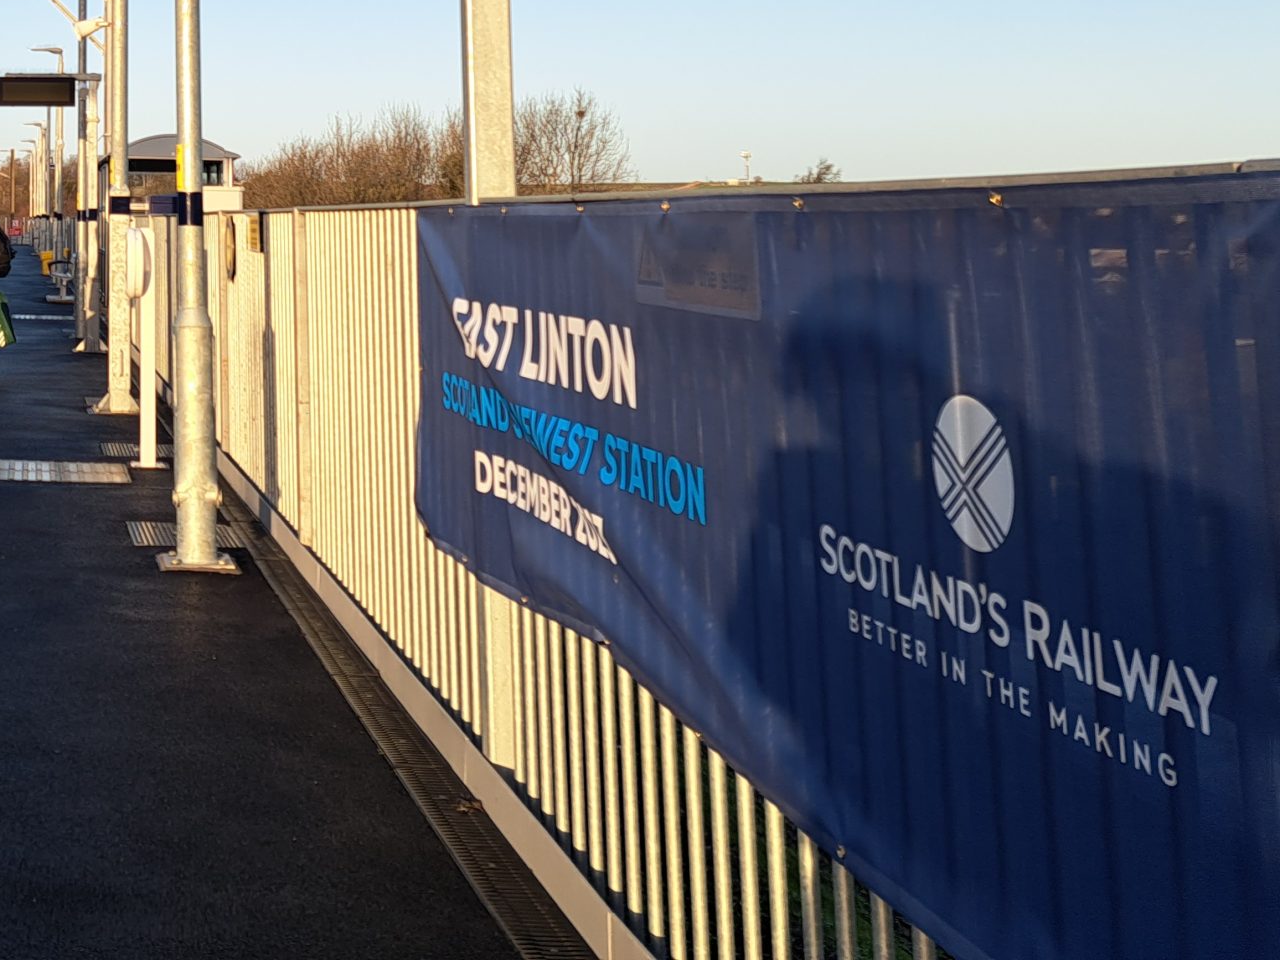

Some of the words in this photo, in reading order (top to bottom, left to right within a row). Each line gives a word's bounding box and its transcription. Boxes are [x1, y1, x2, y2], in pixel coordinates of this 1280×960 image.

[519, 308, 637, 410] LINTON
[474, 450, 572, 537] DECEMBER
[600, 433, 707, 526] STATION
[819, 524, 1010, 648] SCOTLAND'S
[1022, 599, 1218, 736] RAILWAY
[848, 607, 928, 668] BETTER
[941, 651, 967, 686] IN
[981, 669, 1032, 718] THE
[1047, 701, 1179, 787] MAKING
